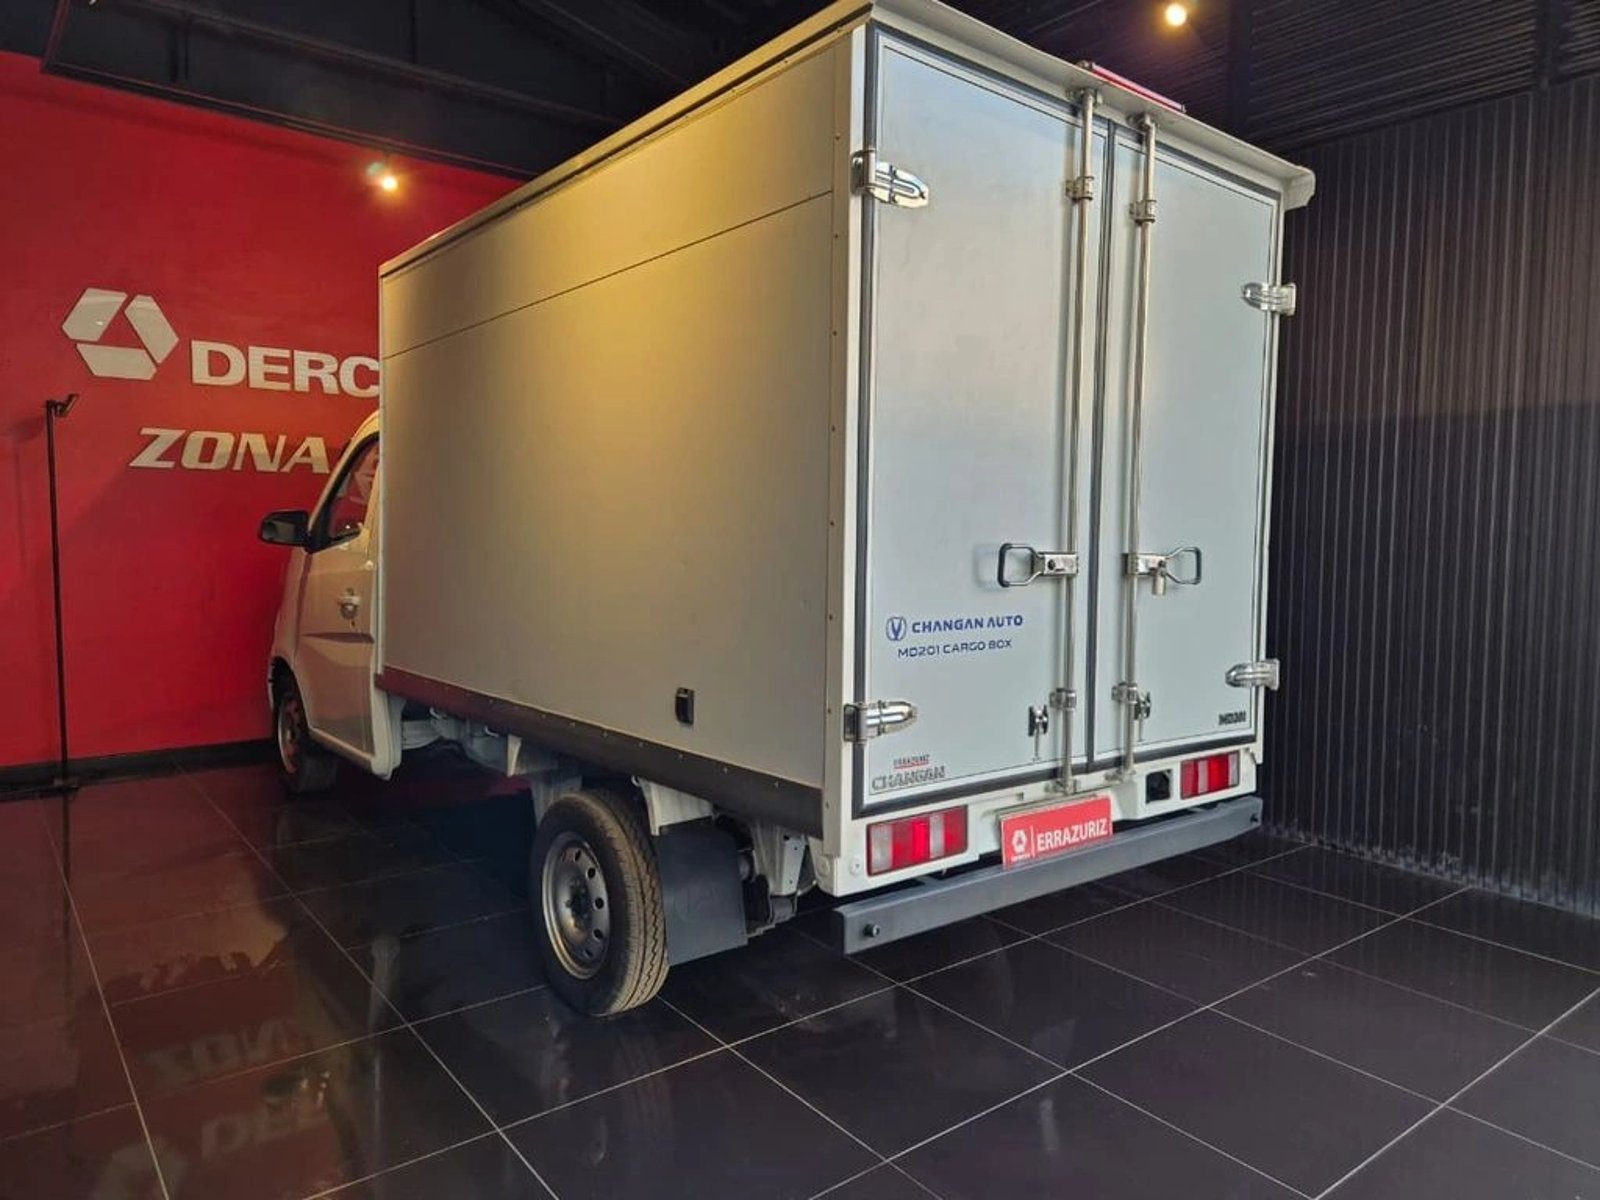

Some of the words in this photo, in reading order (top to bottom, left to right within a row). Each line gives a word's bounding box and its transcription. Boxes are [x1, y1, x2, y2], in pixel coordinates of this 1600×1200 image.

[129, 427, 330, 474] ZONA
[911, 618, 983, 634] CHANGAN
[987, 614, 1023, 628] AUTO
[943, 641, 986, 655] CARGO
[988, 639, 1013, 650] BOX
[1036, 818, 1108, 852] ERRAZURIZ
